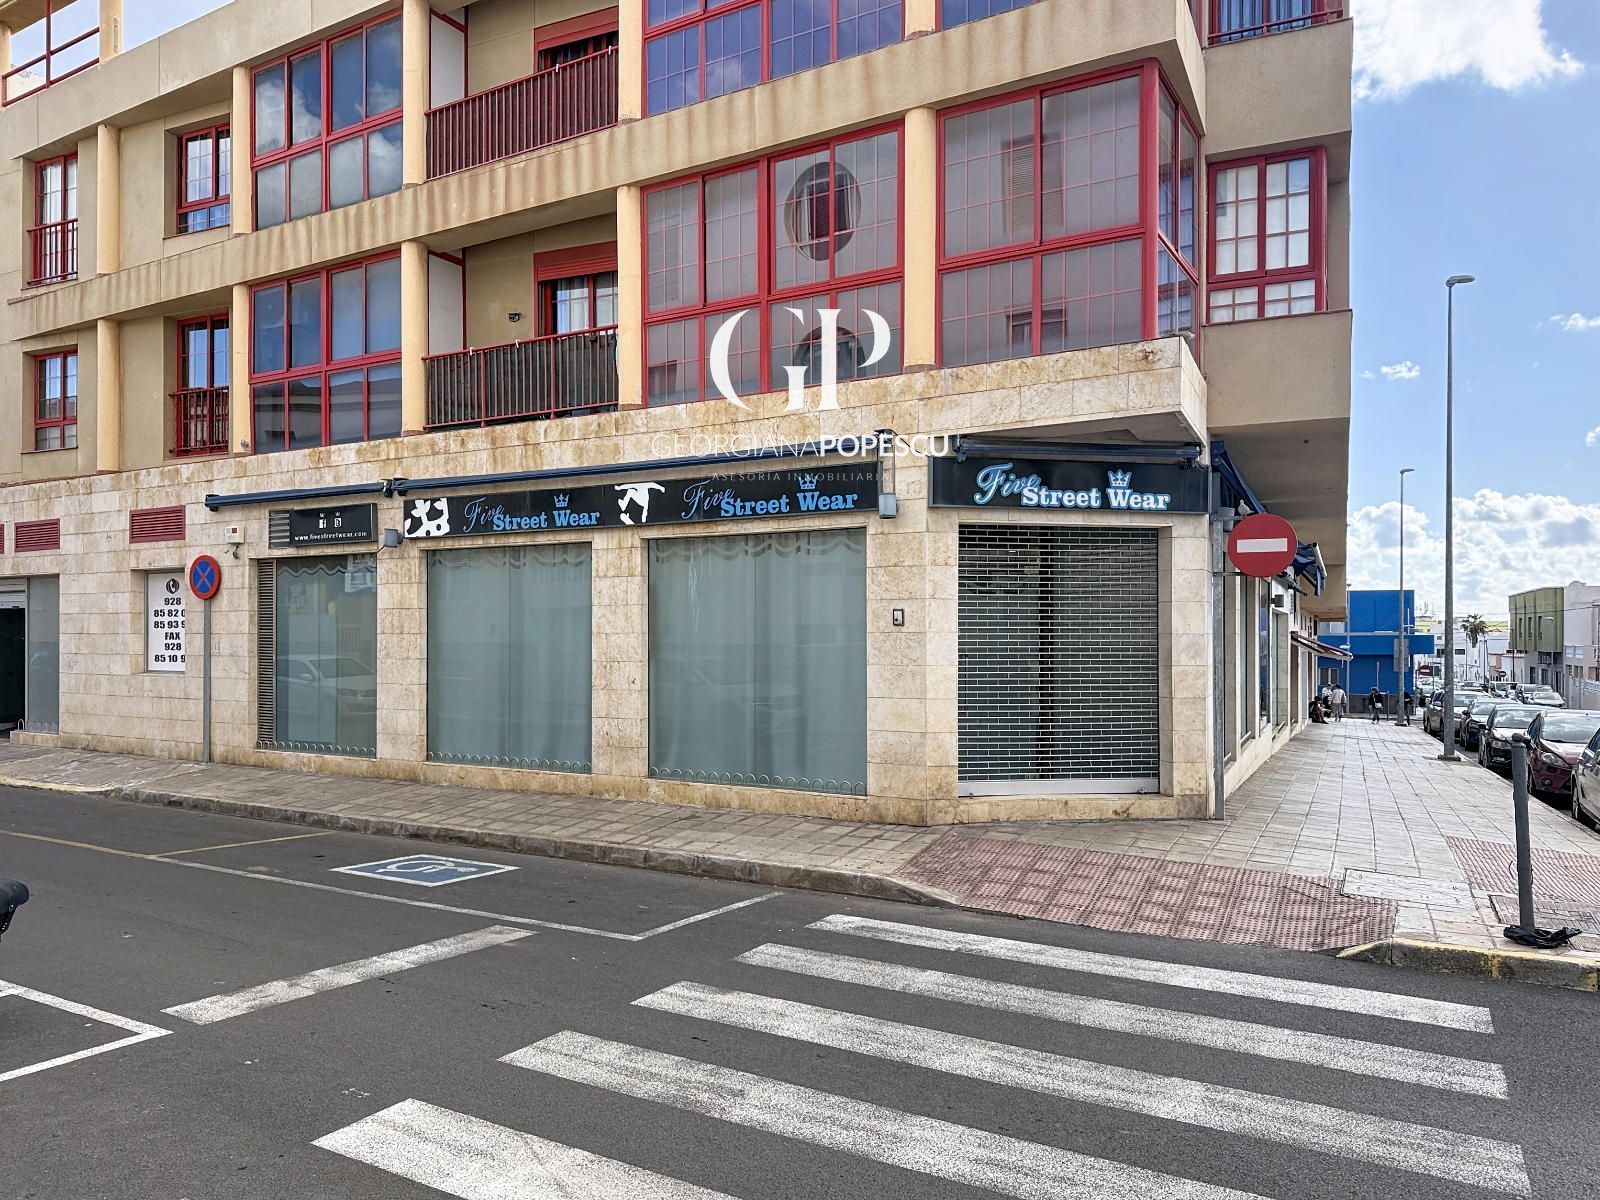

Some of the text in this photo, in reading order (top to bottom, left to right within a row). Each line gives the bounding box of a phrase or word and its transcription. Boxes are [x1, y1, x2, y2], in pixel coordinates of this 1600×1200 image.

[973, 462, 1171, 511] Five Street Wear
[681, 479, 858, 519] Five Street Wear
[463, 496, 600, 533] Five Street Wear
[164, 597, 182, 606] 928
[153, 609, 165, 618] 85
[167, 609, 179, 617] 82
[153, 620, 165, 629] 85
[167, 620, 179, 629] 93
[164, 632, 180, 640] FAX
[164, 643, 182, 651] 928
[154, 654, 166, 663] 85
[168, 654, 178, 663] 10
